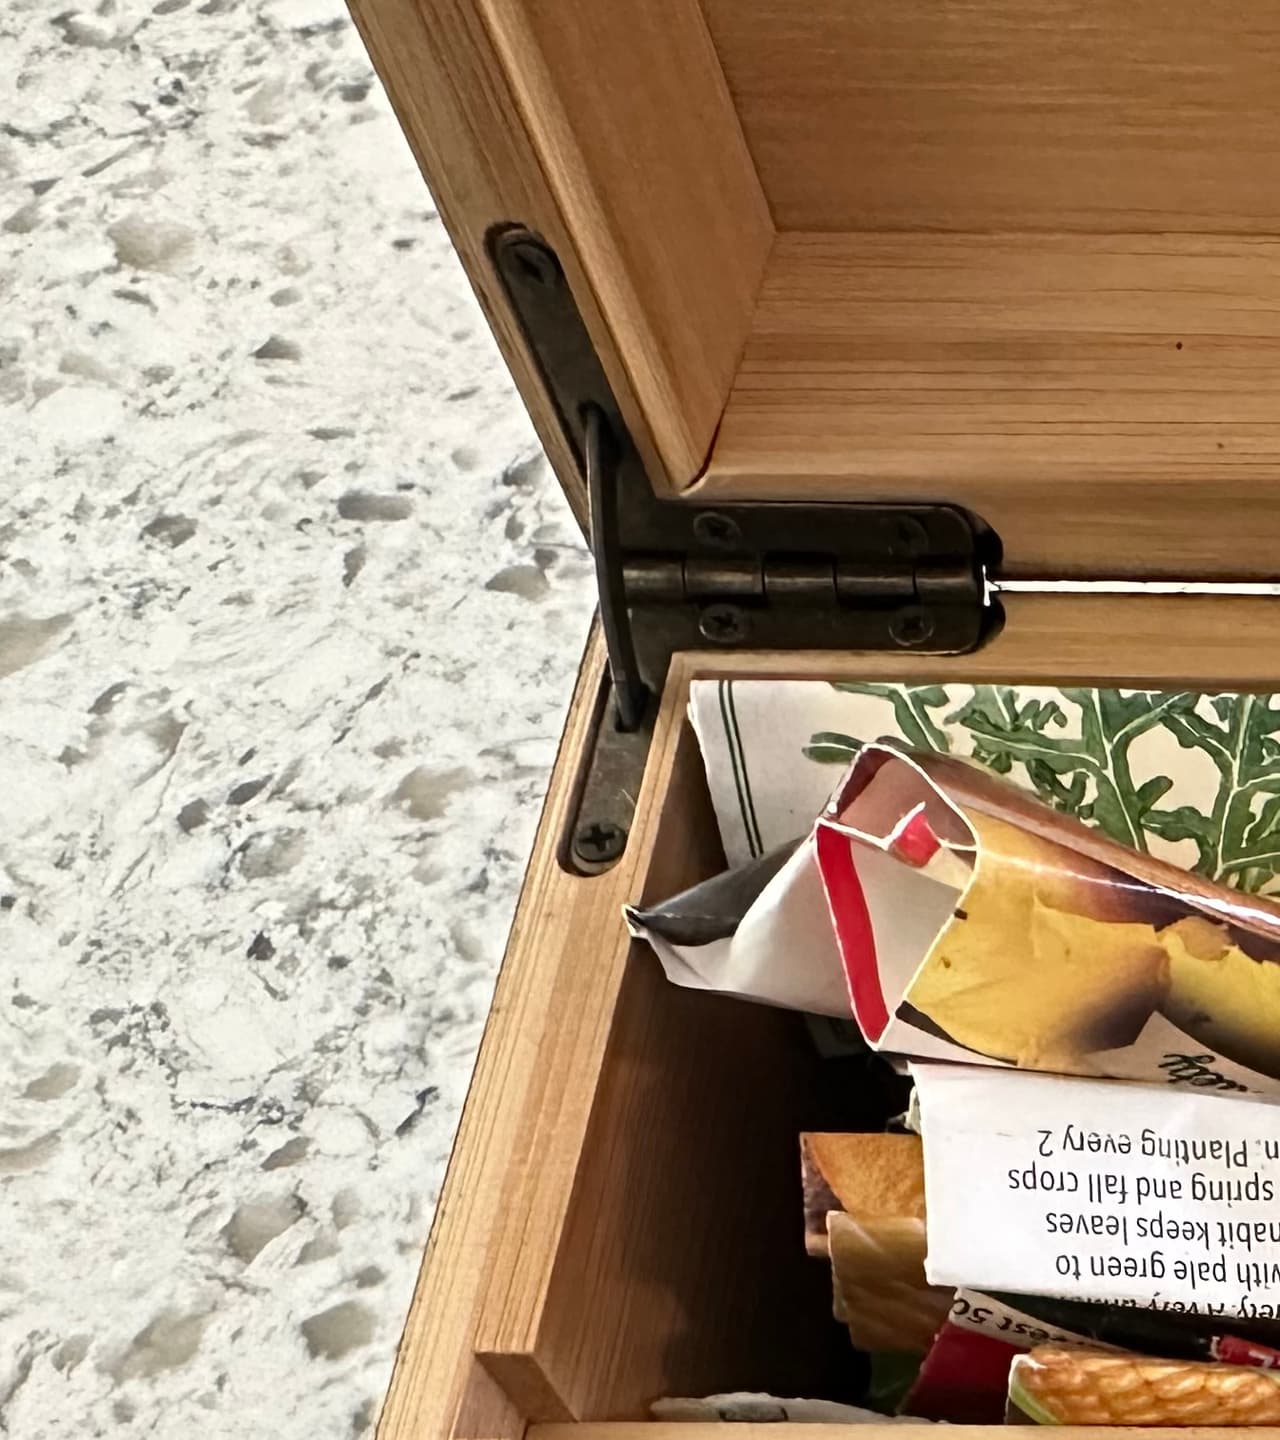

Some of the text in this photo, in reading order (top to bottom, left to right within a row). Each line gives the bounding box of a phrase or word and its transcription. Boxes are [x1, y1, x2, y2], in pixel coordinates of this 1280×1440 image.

[1037, 1130, 1054, 1157] 2
[1062, 1124, 1132, 1155] every
[1140, 1129, 1248, 1169] Planting
[1007, 1160, 1079, 1193] crops
[1089, 1173, 1128, 1205] fall
[1136, 1176, 1183, 1206] and
[1191, 1172, 1274, 1209] spring
[1046, 1212, 1128, 1247] leaves
[1136, 1210, 1210, 1251] keeps
[1056, 1255, 1081, 1281] to
[1090, 1250, 1165, 1280] green
[1173, 1254, 1227, 1290] pale
